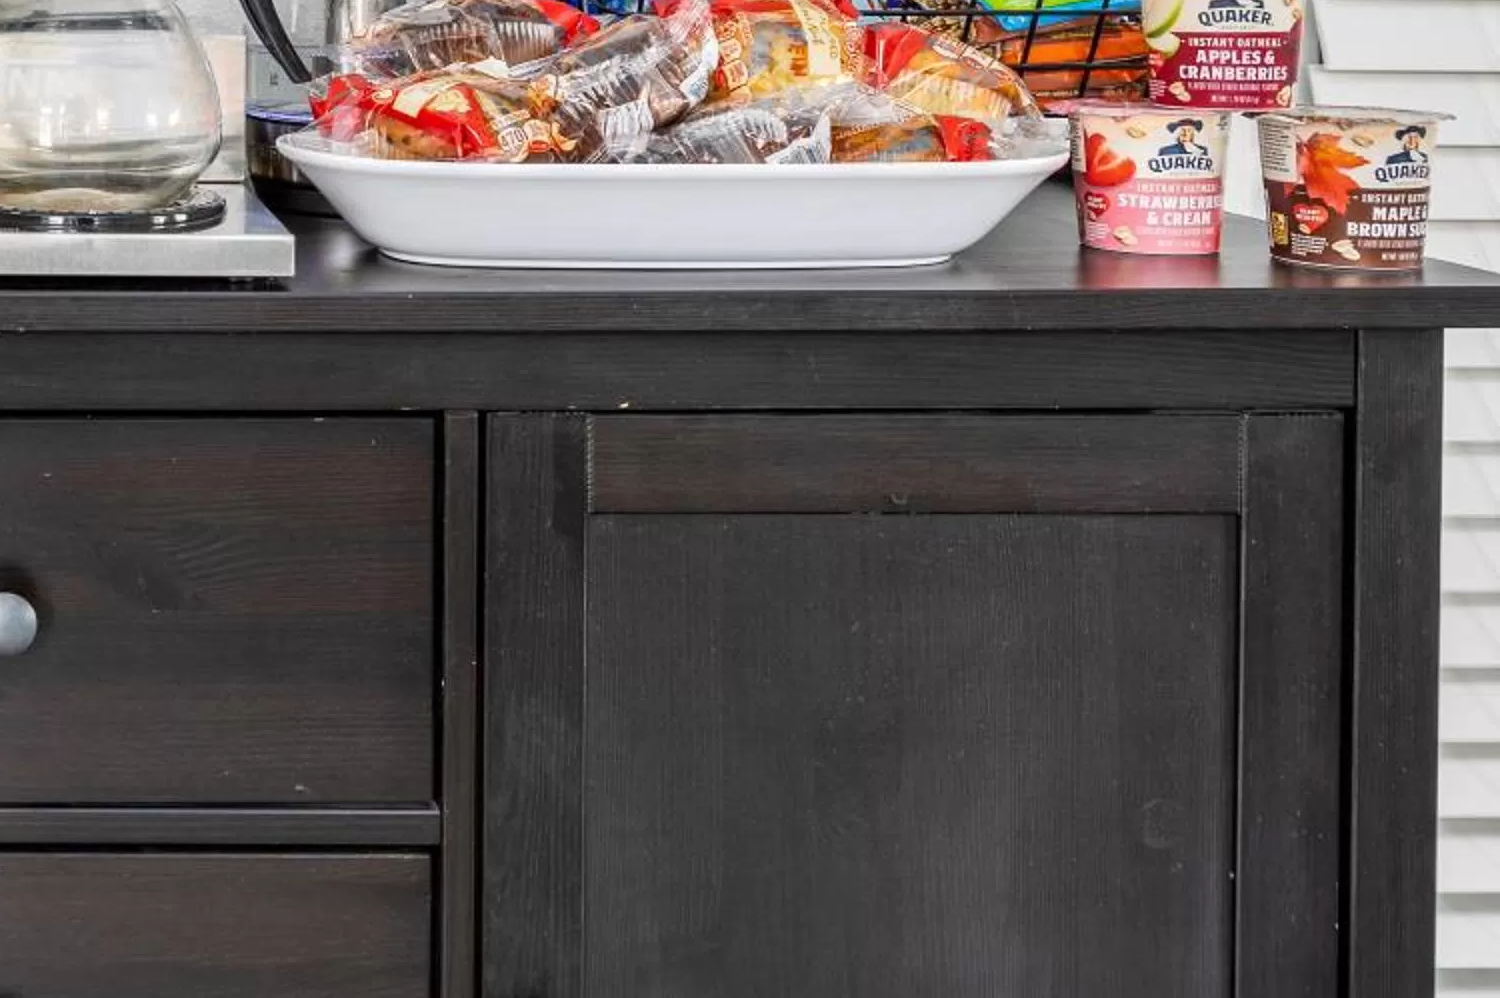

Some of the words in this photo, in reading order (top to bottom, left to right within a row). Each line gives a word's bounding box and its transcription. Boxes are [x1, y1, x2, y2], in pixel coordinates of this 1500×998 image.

[1198, 9, 1273, 26] QUAKER
[1188, 37, 1233, 47] INSTANT
[1196, 50, 1261, 64] APPLES
[1264, 50, 1275, 64] &
[1179, 65, 1288, 81] CRANBERRIES
[1148, 156, 1213, 173] QUAKER
[1361, 193, 1405, 203] INSTANT
[1163, 212, 1212, 226] CREAM
[1372, 206, 1420, 221] MAPLE
[1347, 222, 1407, 237] BROWN
